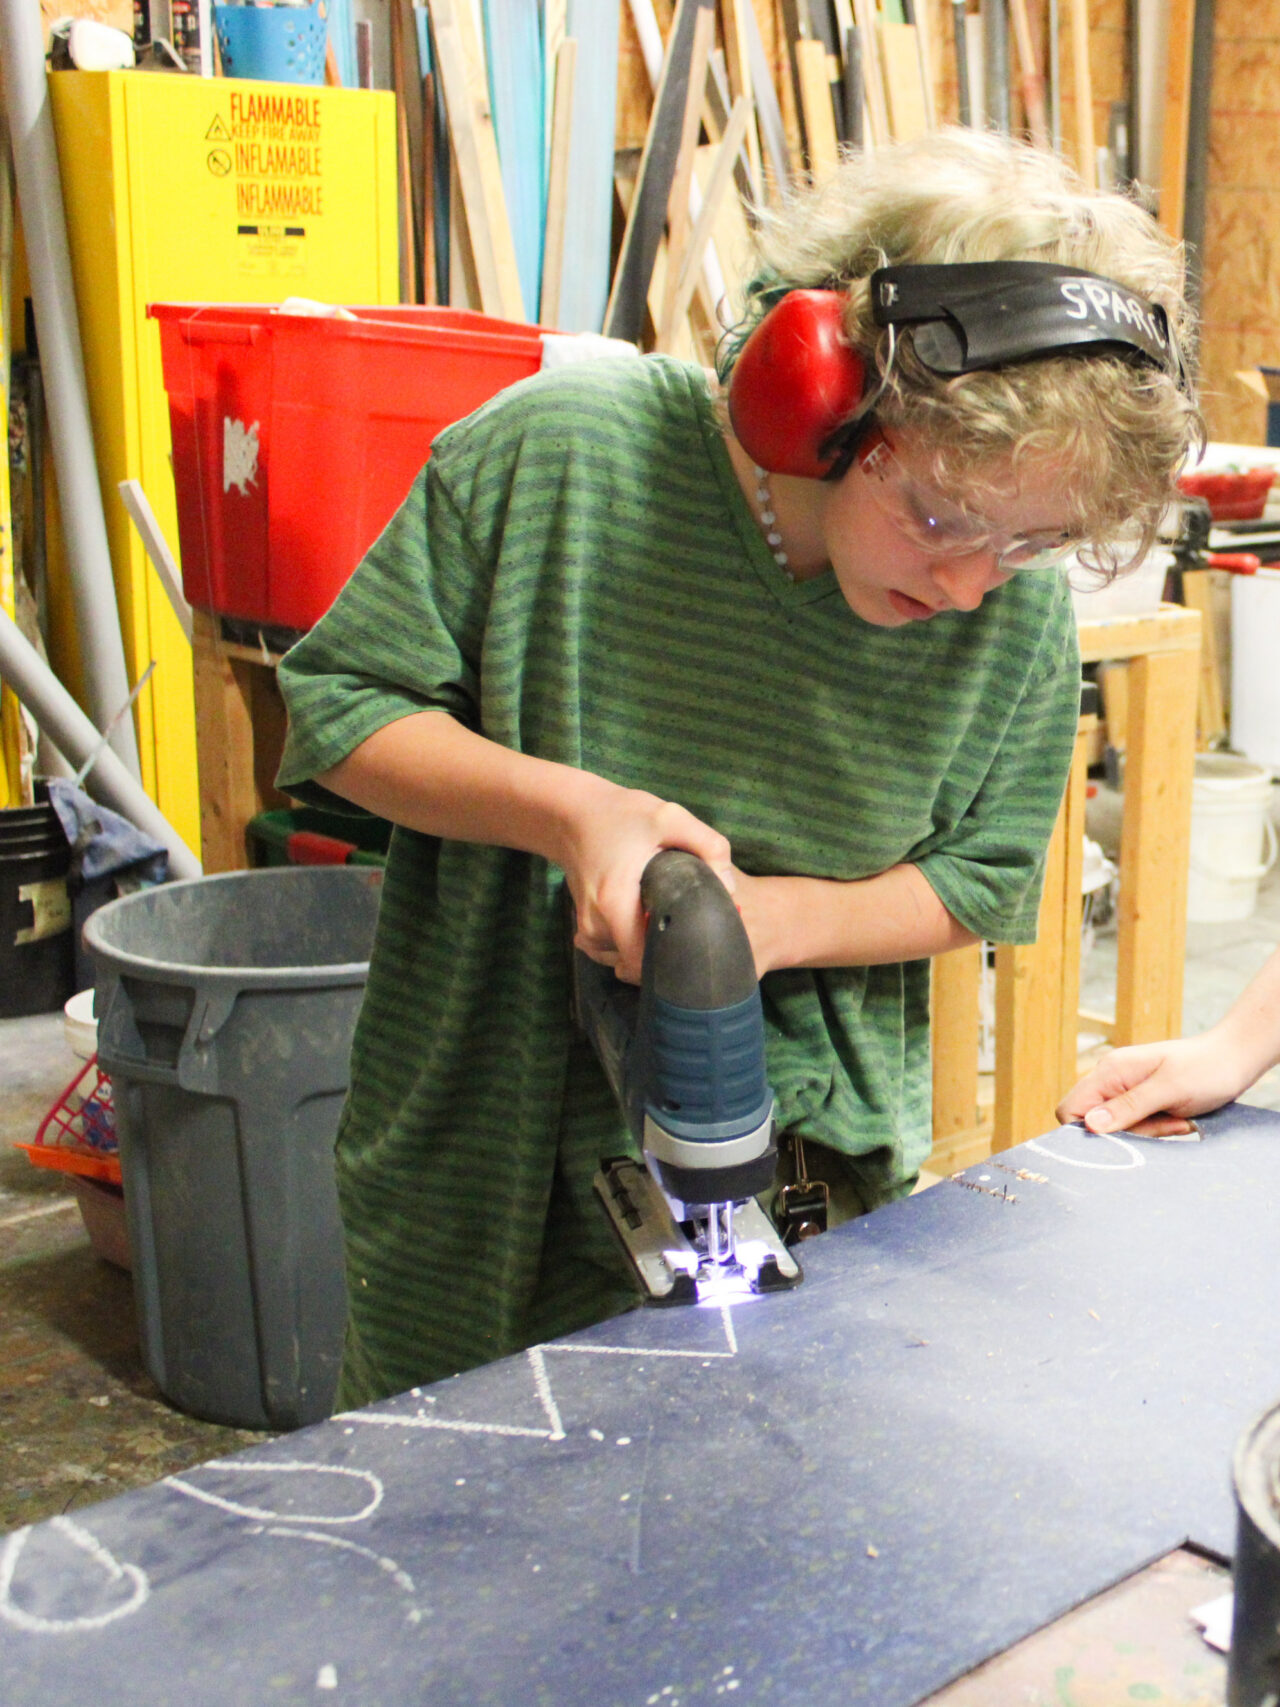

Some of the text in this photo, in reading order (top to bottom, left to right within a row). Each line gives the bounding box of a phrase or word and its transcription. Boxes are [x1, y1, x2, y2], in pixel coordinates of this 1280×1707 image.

[230, 92, 320, 127] FLAMMABLE
[231, 124, 319, 142] KEEP FIRE AWAY
[235, 143, 322, 176] INFLAMABLE
[237, 183, 322, 215] INFLAMMABLE
